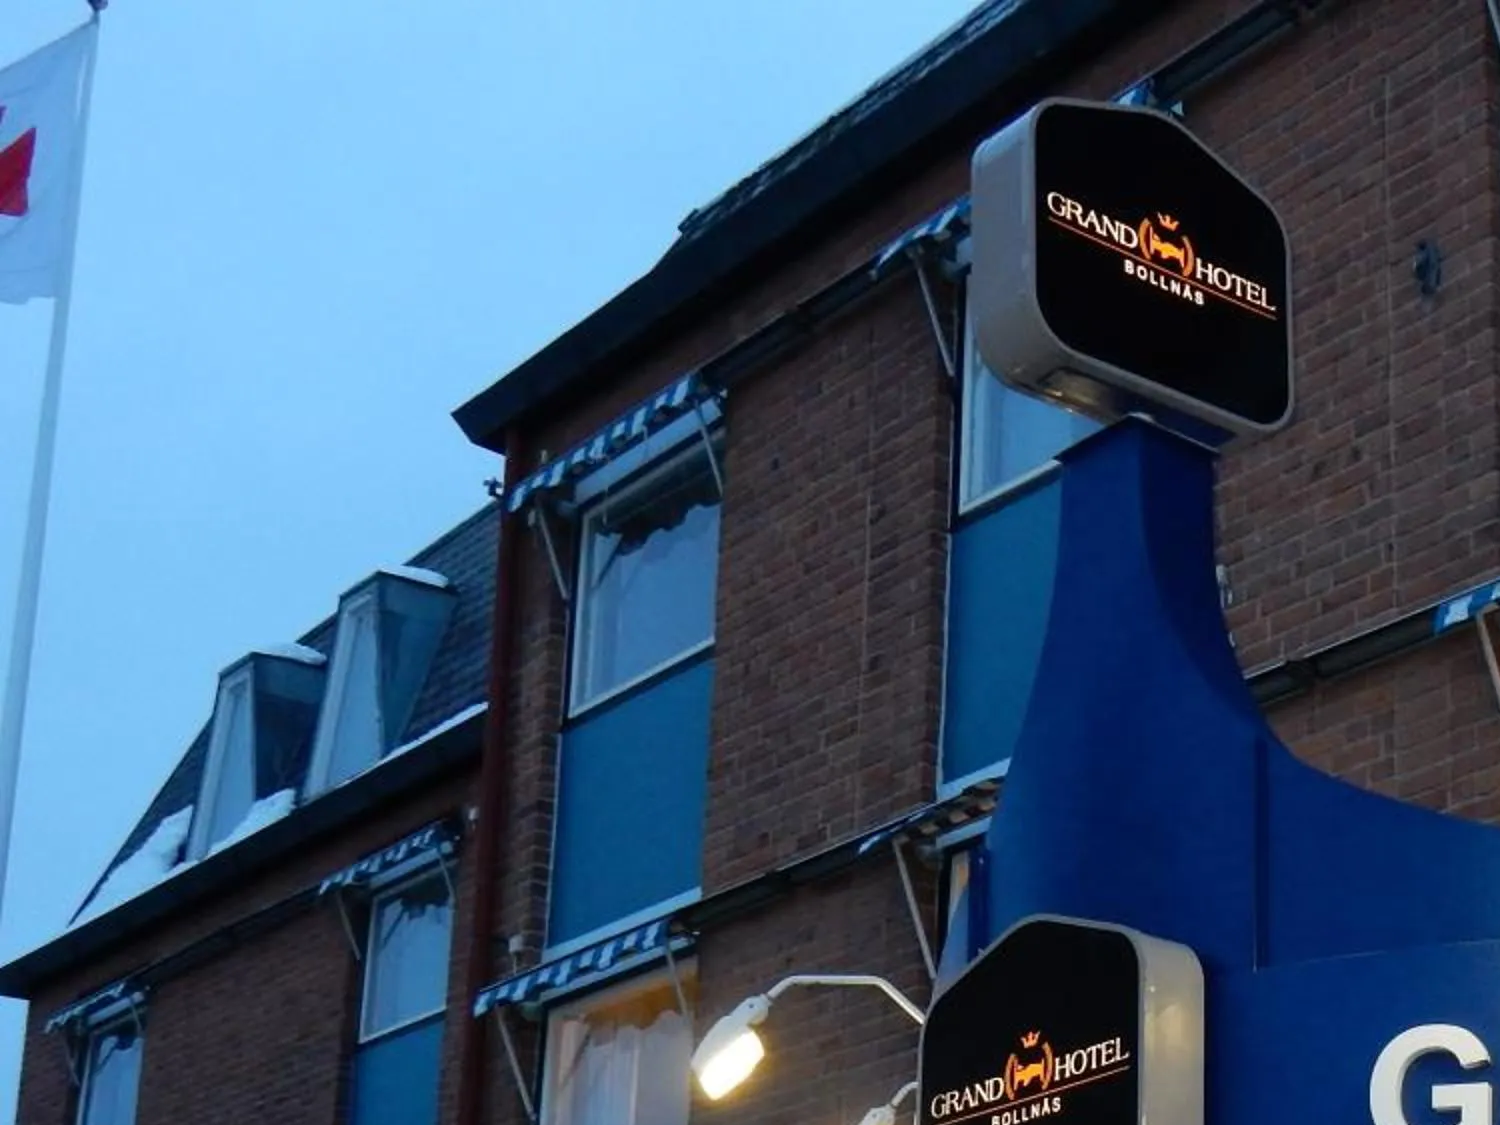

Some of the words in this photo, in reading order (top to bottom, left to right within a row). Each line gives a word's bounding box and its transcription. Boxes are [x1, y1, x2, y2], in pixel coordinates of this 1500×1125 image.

[1047, 192, 1138, 249] GRAND
[1195, 258, 1276, 311] HOTEL
[931, 1077, 1004, 1118] GRAND
[1054, 1037, 1130, 1081] HOTEL
